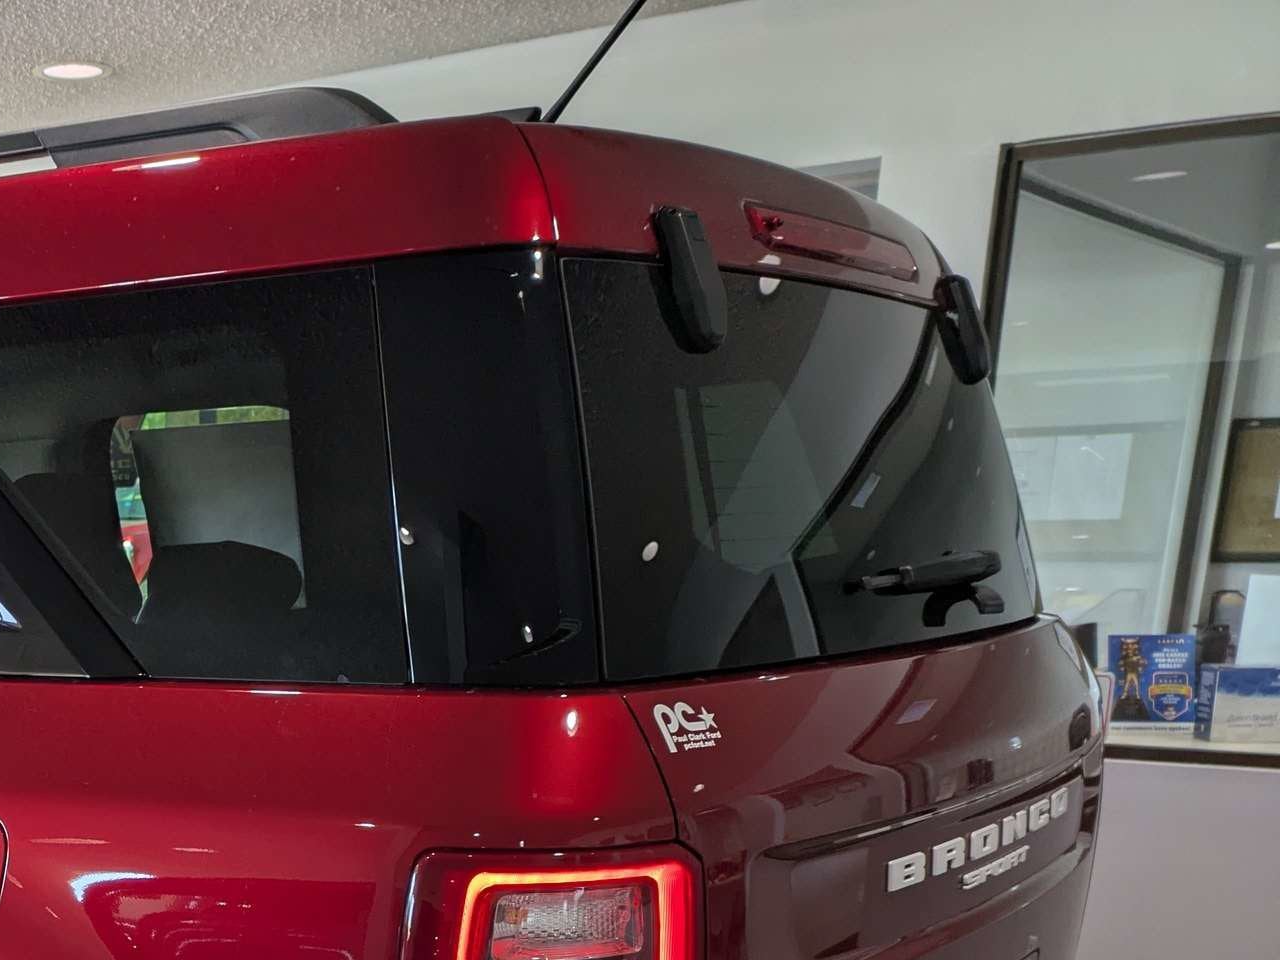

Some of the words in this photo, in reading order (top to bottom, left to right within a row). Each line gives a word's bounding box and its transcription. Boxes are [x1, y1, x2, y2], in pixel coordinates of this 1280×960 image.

[672, 734, 688, 743] Paul
[688, 732, 706, 741] Clark
[706, 730, 722, 740] Ford
[683, 740, 716, 751] pcford.net
[887, 787, 1069, 893] BRONCO
[961, 845, 1031, 890] SPORT
